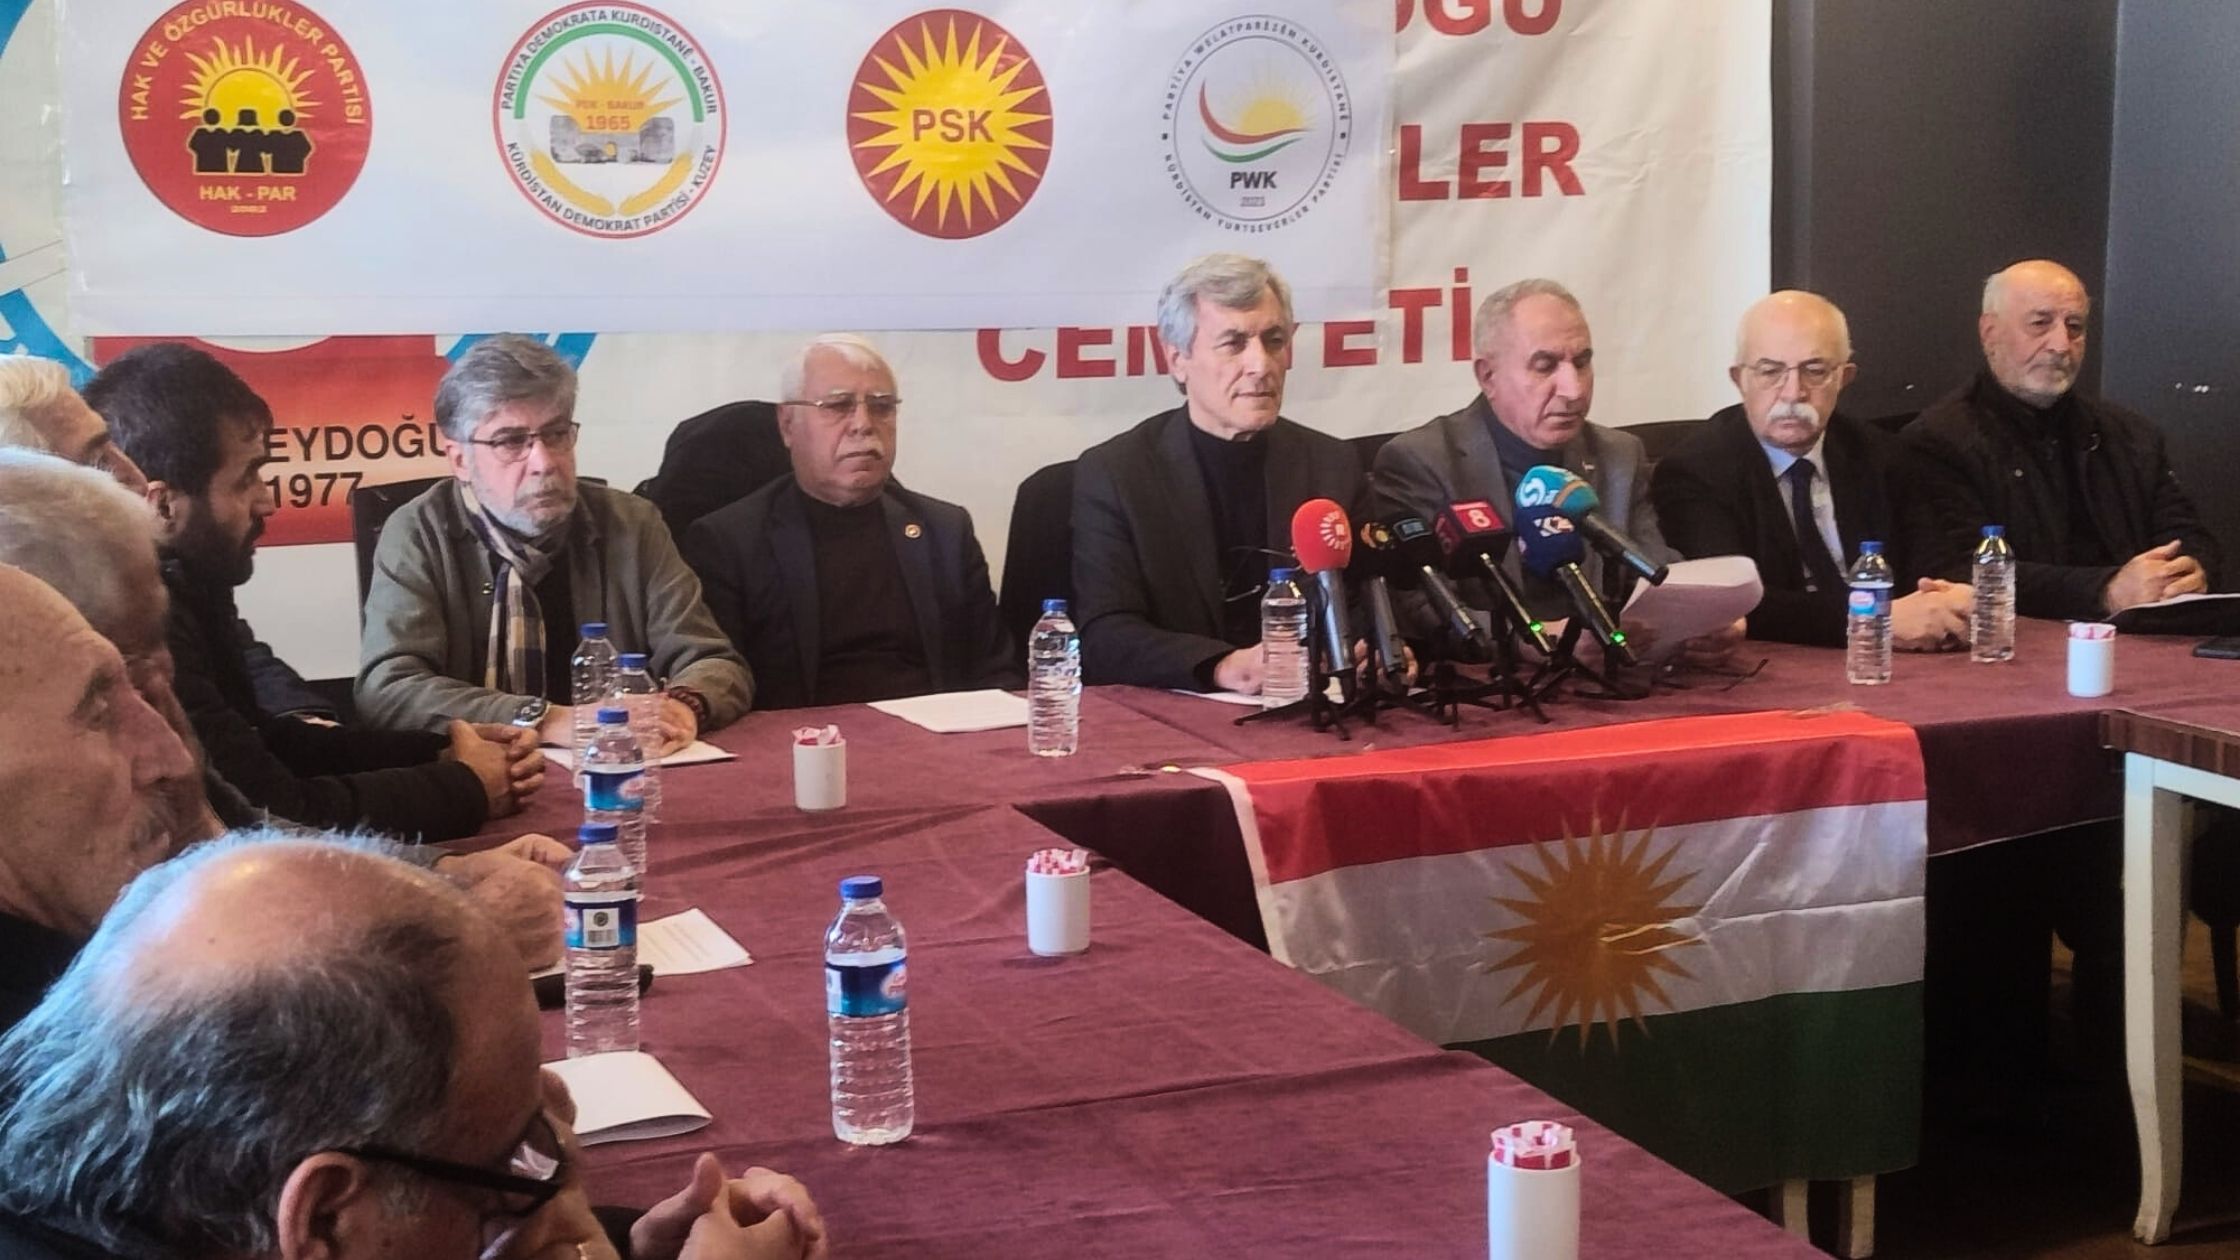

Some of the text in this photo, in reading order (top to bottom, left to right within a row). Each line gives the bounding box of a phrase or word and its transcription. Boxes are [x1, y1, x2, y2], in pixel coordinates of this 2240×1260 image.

[586, 115, 631, 130] 1965
[912, 108, 995, 143] PSK
[1230, 170, 1278, 190] PWK
[199, 185, 241, 200] HAK
[257, 185, 297, 201] PAR
